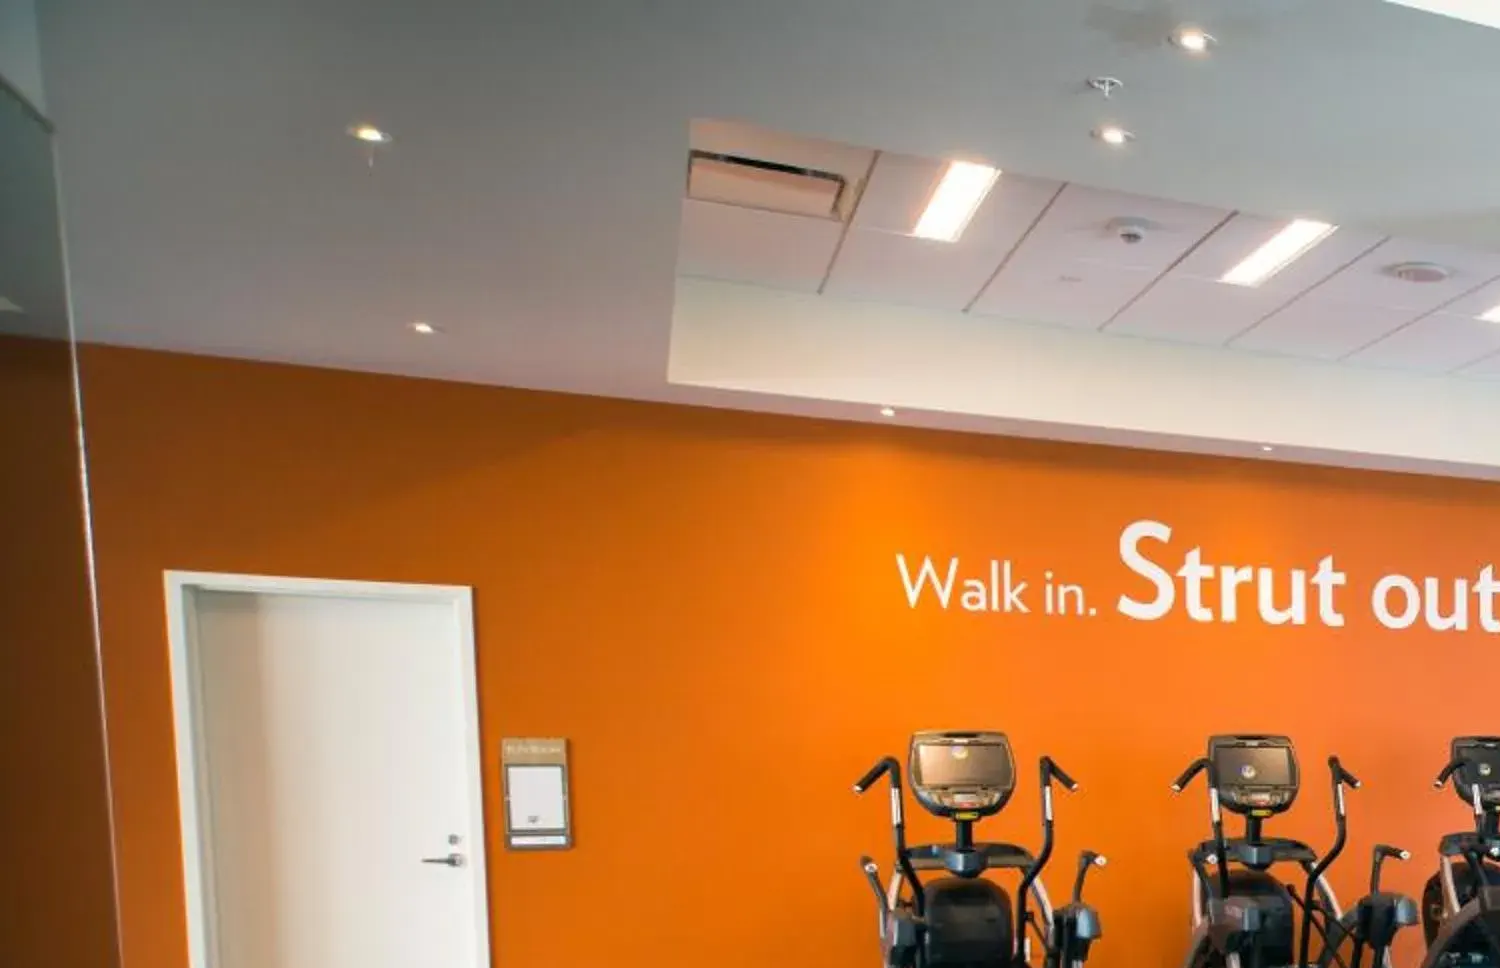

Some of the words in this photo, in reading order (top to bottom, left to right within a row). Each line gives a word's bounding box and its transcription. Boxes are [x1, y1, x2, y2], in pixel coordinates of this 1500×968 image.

[896, 554, 1028, 612] Walk
[1044, 570, 1097, 616] in.
[1116, 519, 1346, 627] Strut
